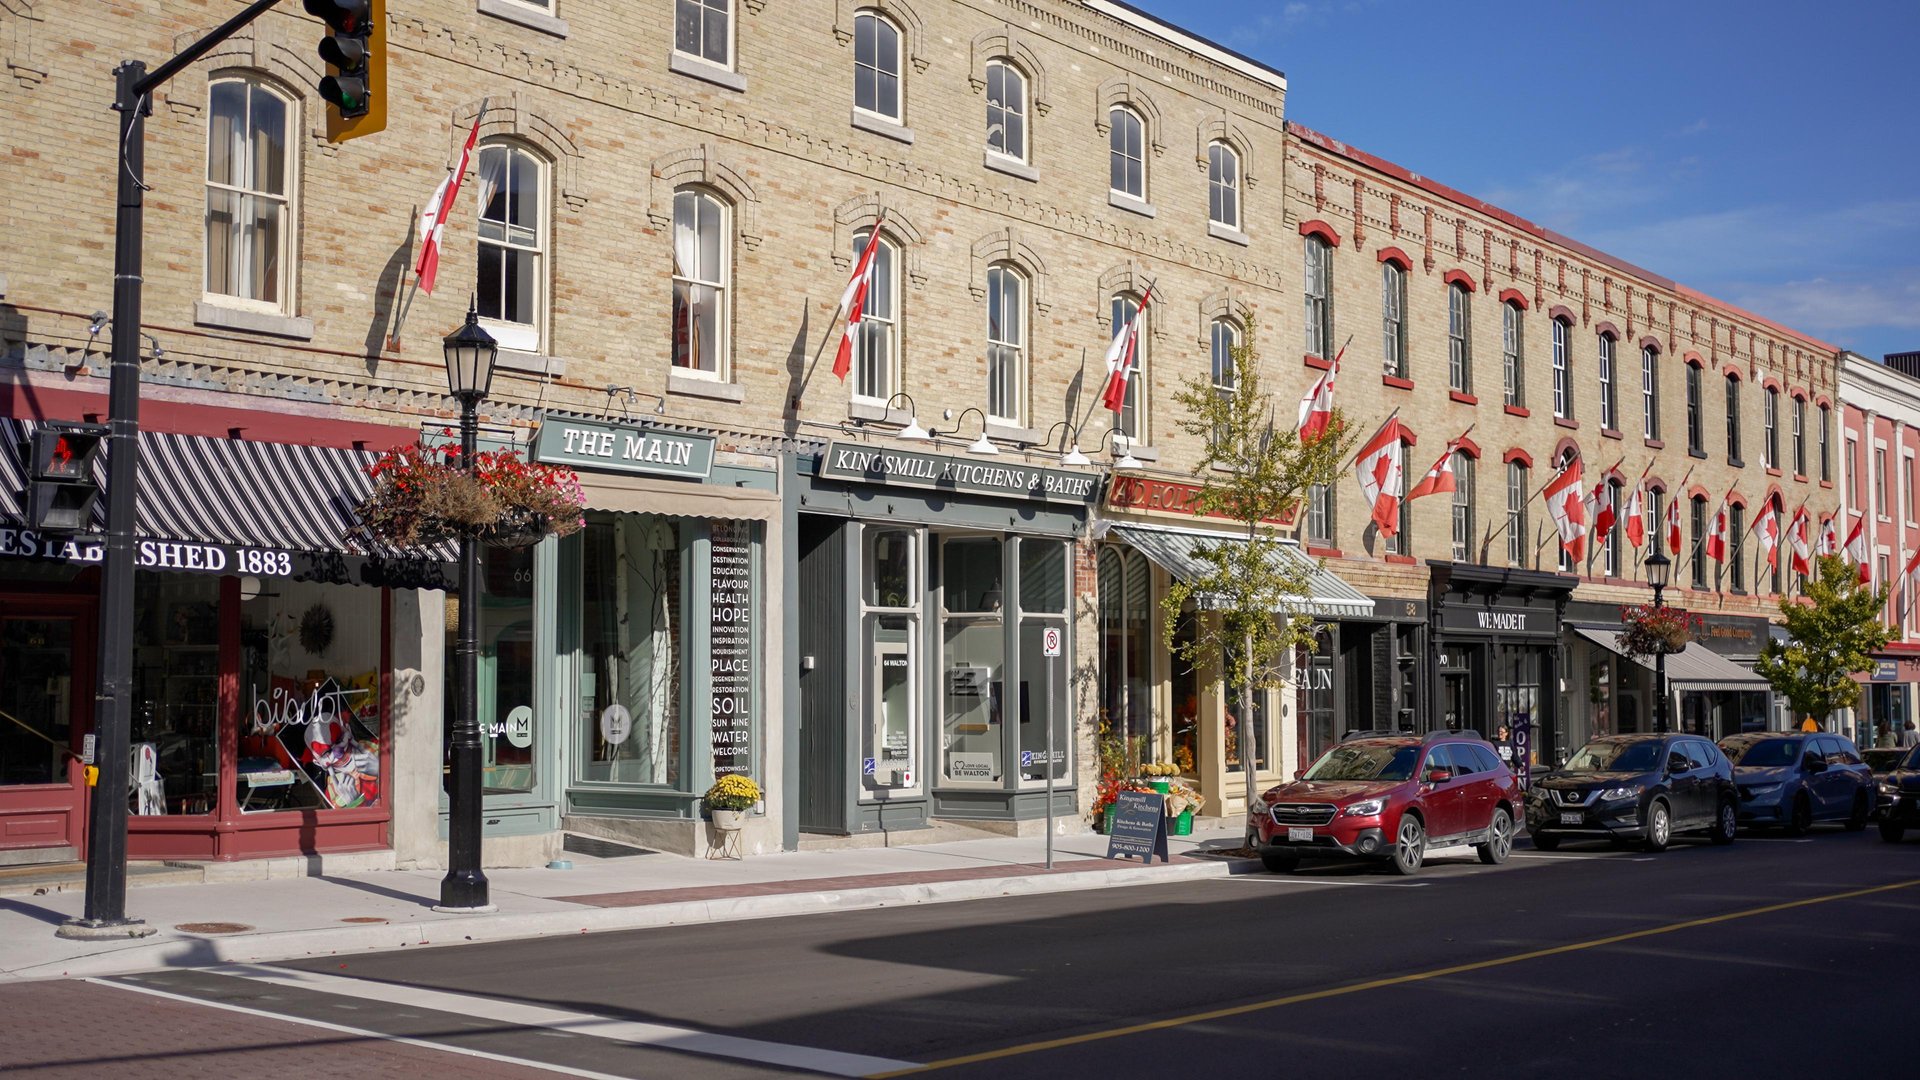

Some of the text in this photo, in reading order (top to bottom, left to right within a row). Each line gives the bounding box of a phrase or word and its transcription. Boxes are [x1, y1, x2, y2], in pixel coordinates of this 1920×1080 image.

[563, 428, 693, 467] THE MAIN
[834, 449, 1092, 496] KINGSMILL KITCHENS & BATHS
[712, 546, 749, 554] CONSERVATION
[236, 548, 292, 577] 1883
[712, 556, 749, 565] DESTINATION
[513, 568, 532, 582] 66
[712, 567, 749, 576] EDUCATION
[712, 579, 749, 589] FLAVOUR
[712, 592, 749, 604] HEALTH
[712, 607, 749, 622] HOPE
[1477, 611, 1526, 630] WE MADE IT
[712, 637, 749, 645] INSPIRATION
[712, 659, 748, 672] PLACE
[252, 682, 370, 729] bibelot
[712, 697, 748, 714] SOIL
[490, 723, 516, 734] MAIN
[712, 731, 748, 743] WATER
[712, 747, 748, 756] WELCOME
[715, 765, 748, 773] OPETOWNS.CA
[1119, 794, 1146, 803] Kingsmill
[1133, 803, 1159, 813] Kitchens
